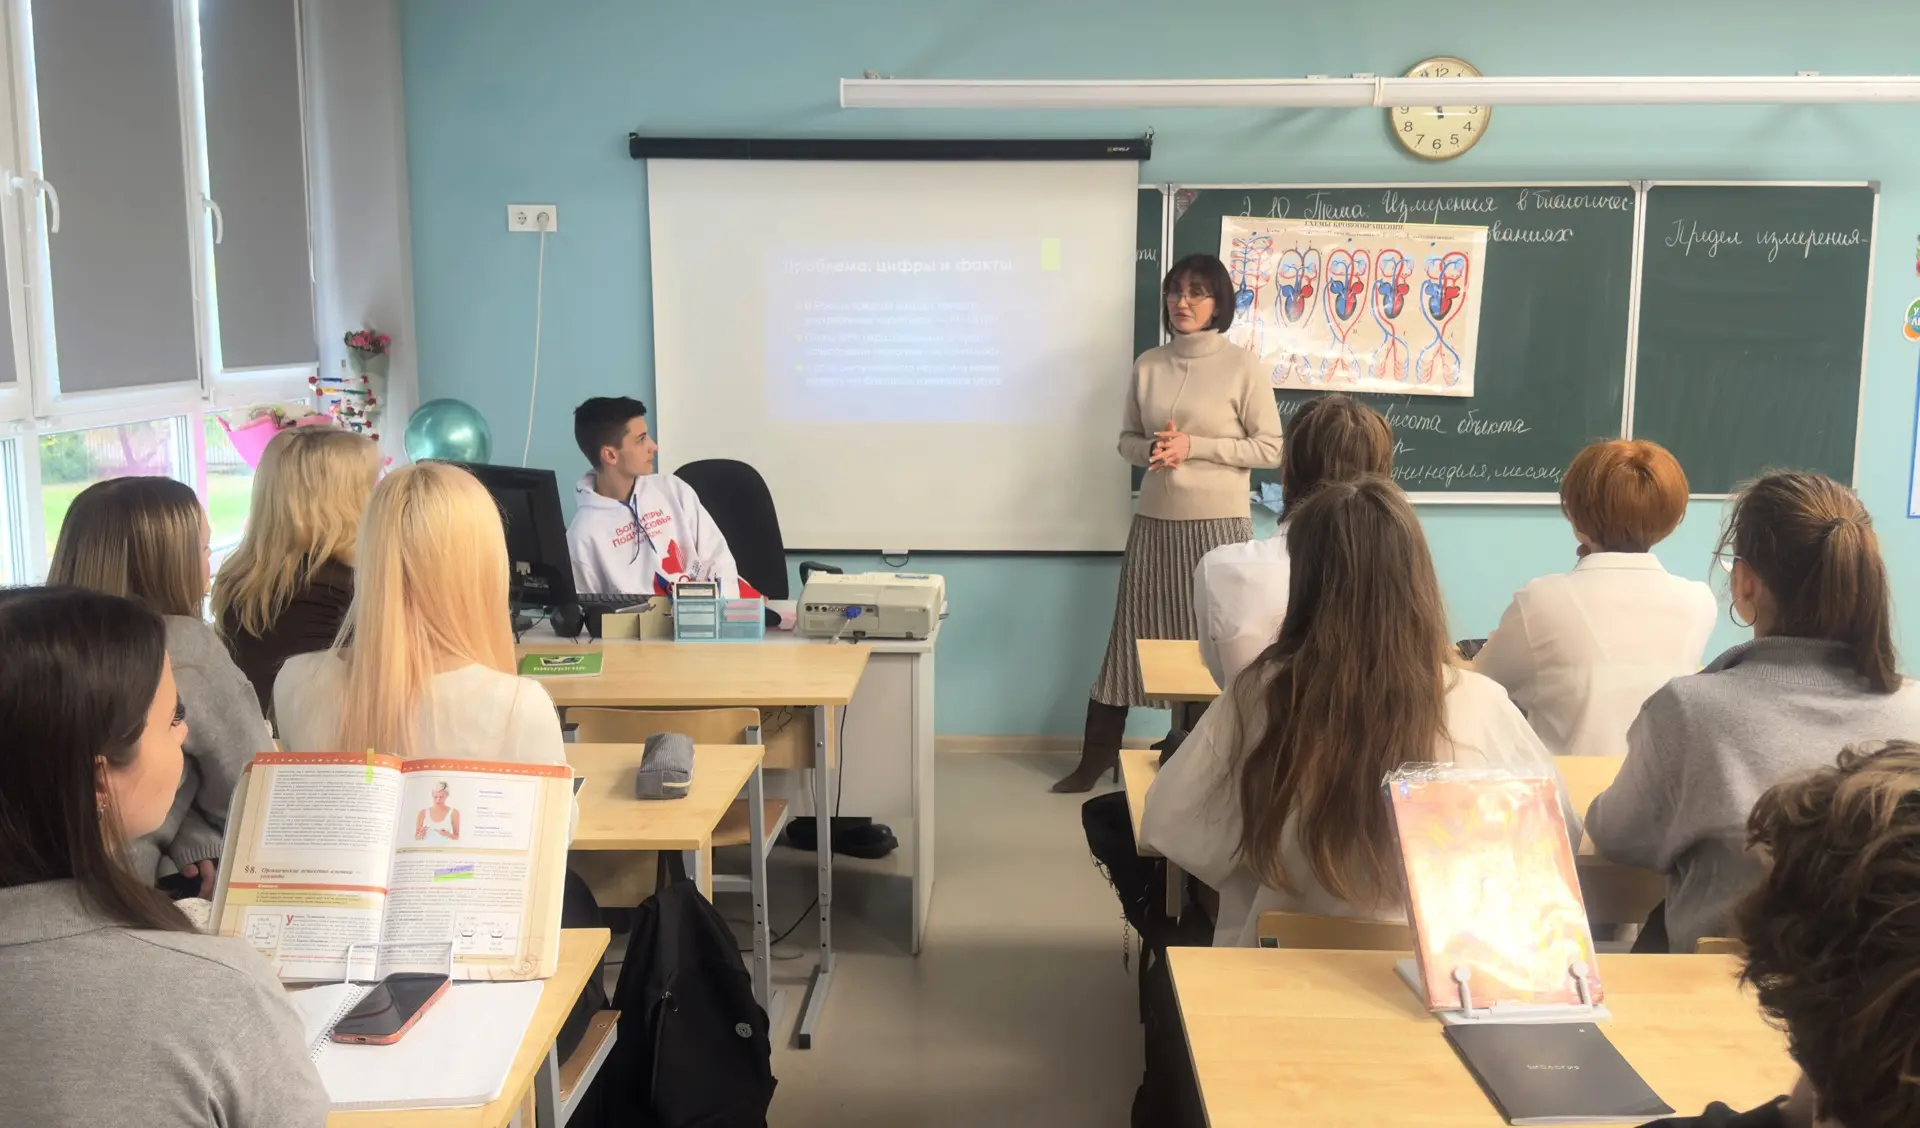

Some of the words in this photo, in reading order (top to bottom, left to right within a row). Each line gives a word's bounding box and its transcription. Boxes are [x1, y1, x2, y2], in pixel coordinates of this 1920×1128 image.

[1436, 67, 1449, 78] 12
[1400, 105, 1409, 115] 9
[1468, 105, 1478, 115] 3
[1403, 121, 1413, 132] 8
[1463, 121, 1472, 132] 4
[1416, 134, 1425, 145] 7
[1432, 139, 1442, 150] 6
[1449, 133, 1459, 145] 5
[1382, 189, 1498, 225] Измерения
[1516, 188, 1531, 211] в
[1665, 219, 1743, 258] Предел
[876, 258, 937, 277] цифры
[940, 260, 950, 272] и
[955, 257, 1013, 274] факты
